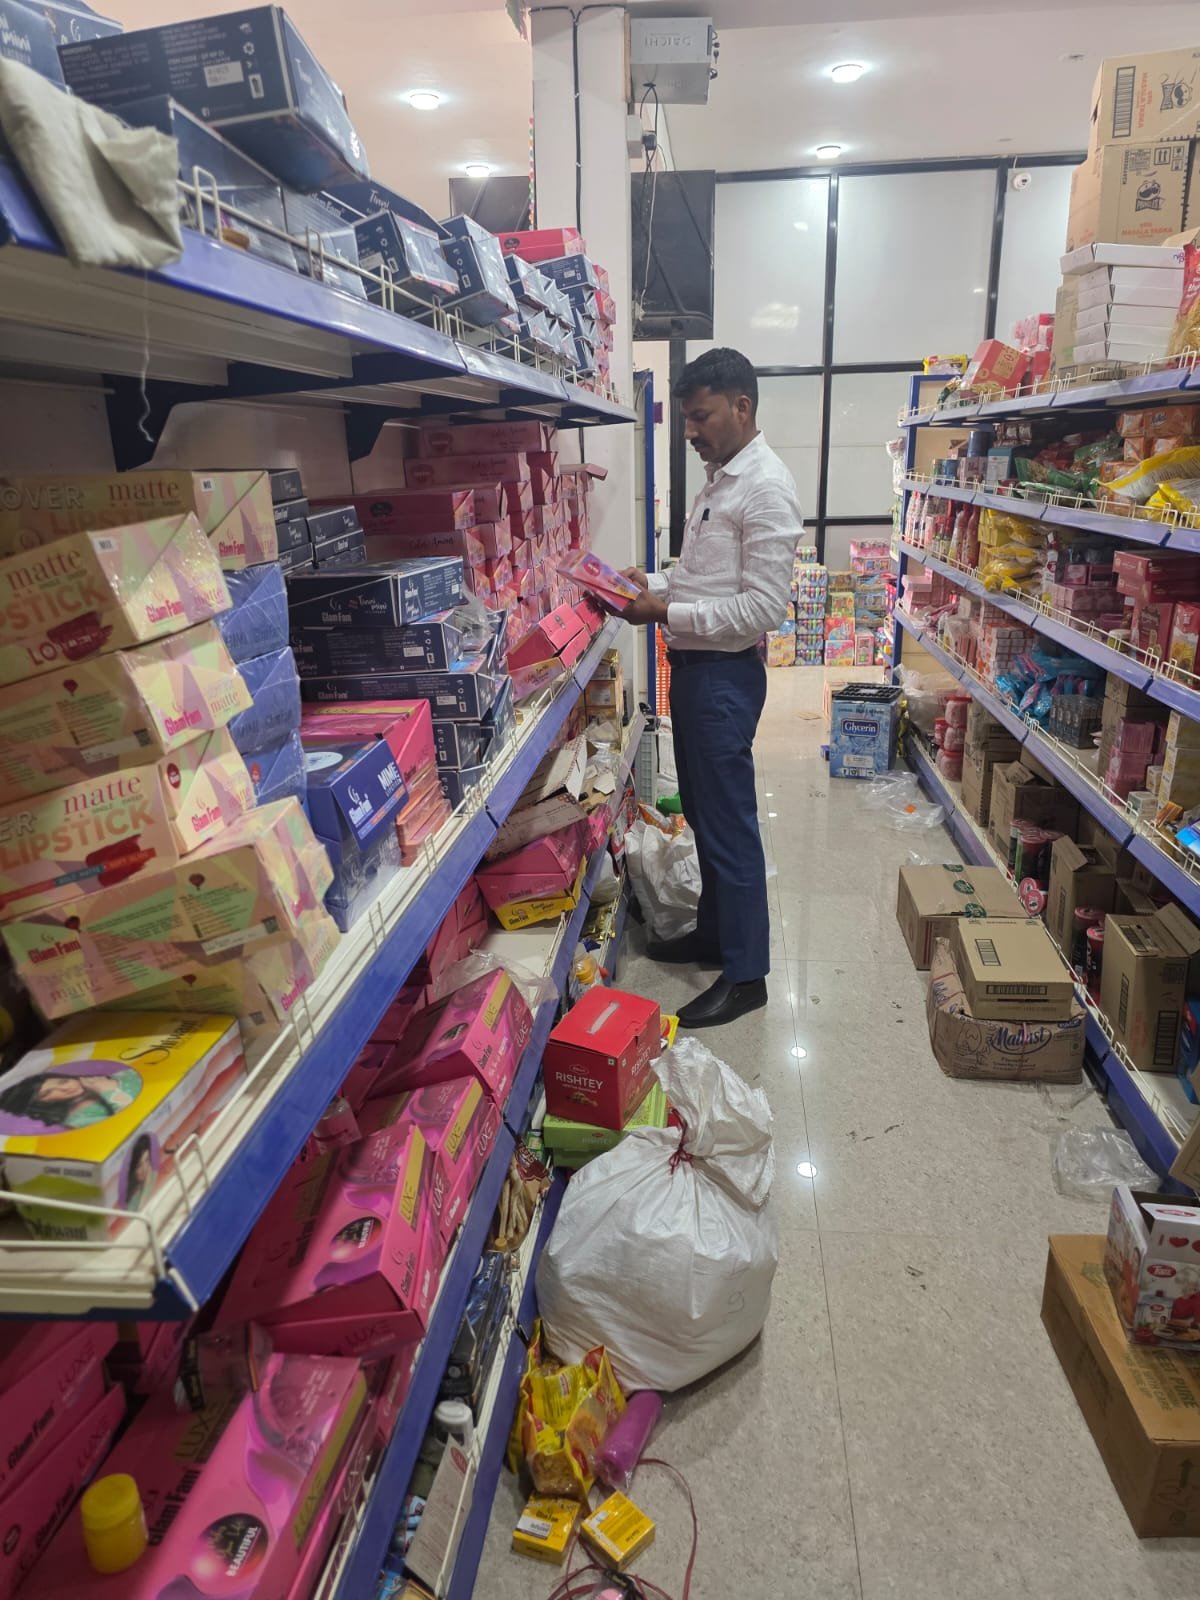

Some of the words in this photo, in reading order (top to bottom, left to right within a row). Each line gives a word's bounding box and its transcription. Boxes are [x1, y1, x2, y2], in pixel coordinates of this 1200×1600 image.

[108, 480, 181, 502] matte
[6, 550, 81, 591] matte
[210, 690, 240, 715] matte
[844, 721, 877, 734] Glycerin
[64, 776, 141, 816] matte
[0, 799, 156, 871] LIPSTICK
[555, 1071, 604, 1090] RISHTEY
[477, 1121, 494, 1157] LUXE
[43, 1165, 62, 1176] ONE
[432, 1173, 446, 1217] LUXE
[225, 1525, 260, 1578] BEAUTIFUL
